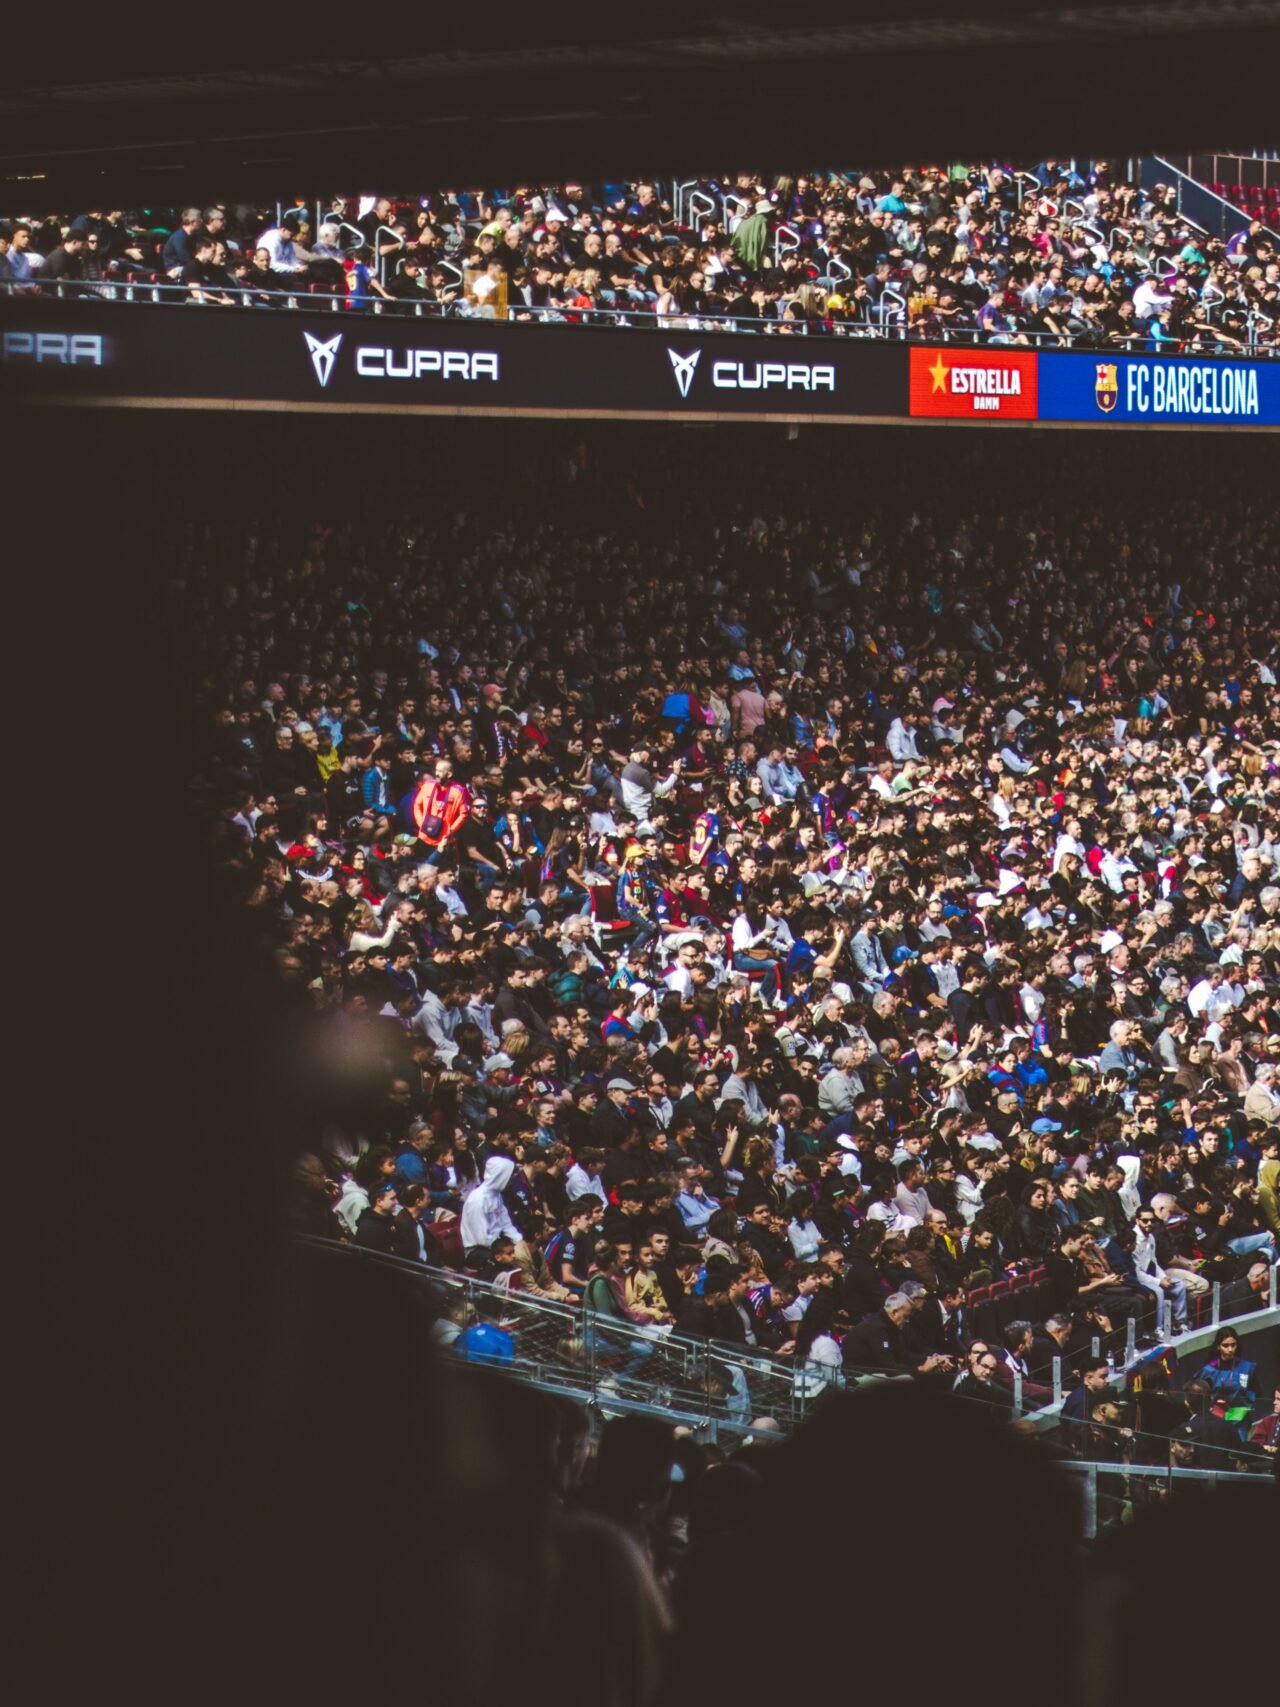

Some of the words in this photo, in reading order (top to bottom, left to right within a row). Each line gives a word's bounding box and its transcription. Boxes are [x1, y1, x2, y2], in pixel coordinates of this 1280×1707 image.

[356, 347, 498, 381] CUPRA
[712, 361, 835, 391] CUPRA
[951, 367, 1021, 395] ESTRELLA
[1127, 364, 1149, 412] FC
[1153, 365, 1259, 415] BARCELONA
[973, 396, 1000, 410] DAMM
